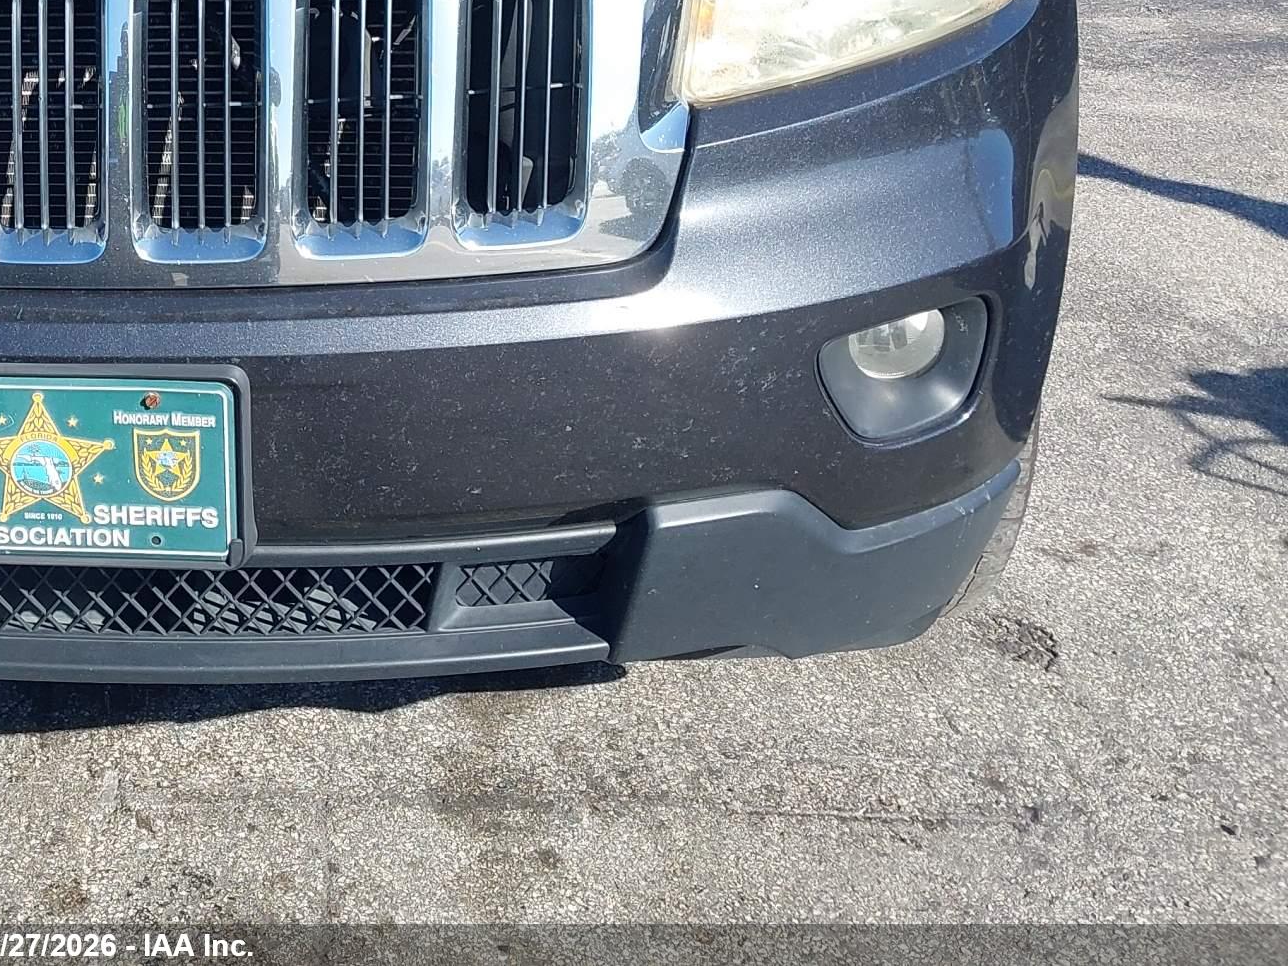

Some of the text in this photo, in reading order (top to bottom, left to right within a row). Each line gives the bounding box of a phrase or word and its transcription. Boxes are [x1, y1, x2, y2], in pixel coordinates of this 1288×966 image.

[20, 432, 58, 443] FLORIDA
[24, 512, 46, 520] SINCE
[93, 504, 219, 528] SHERIFFS
